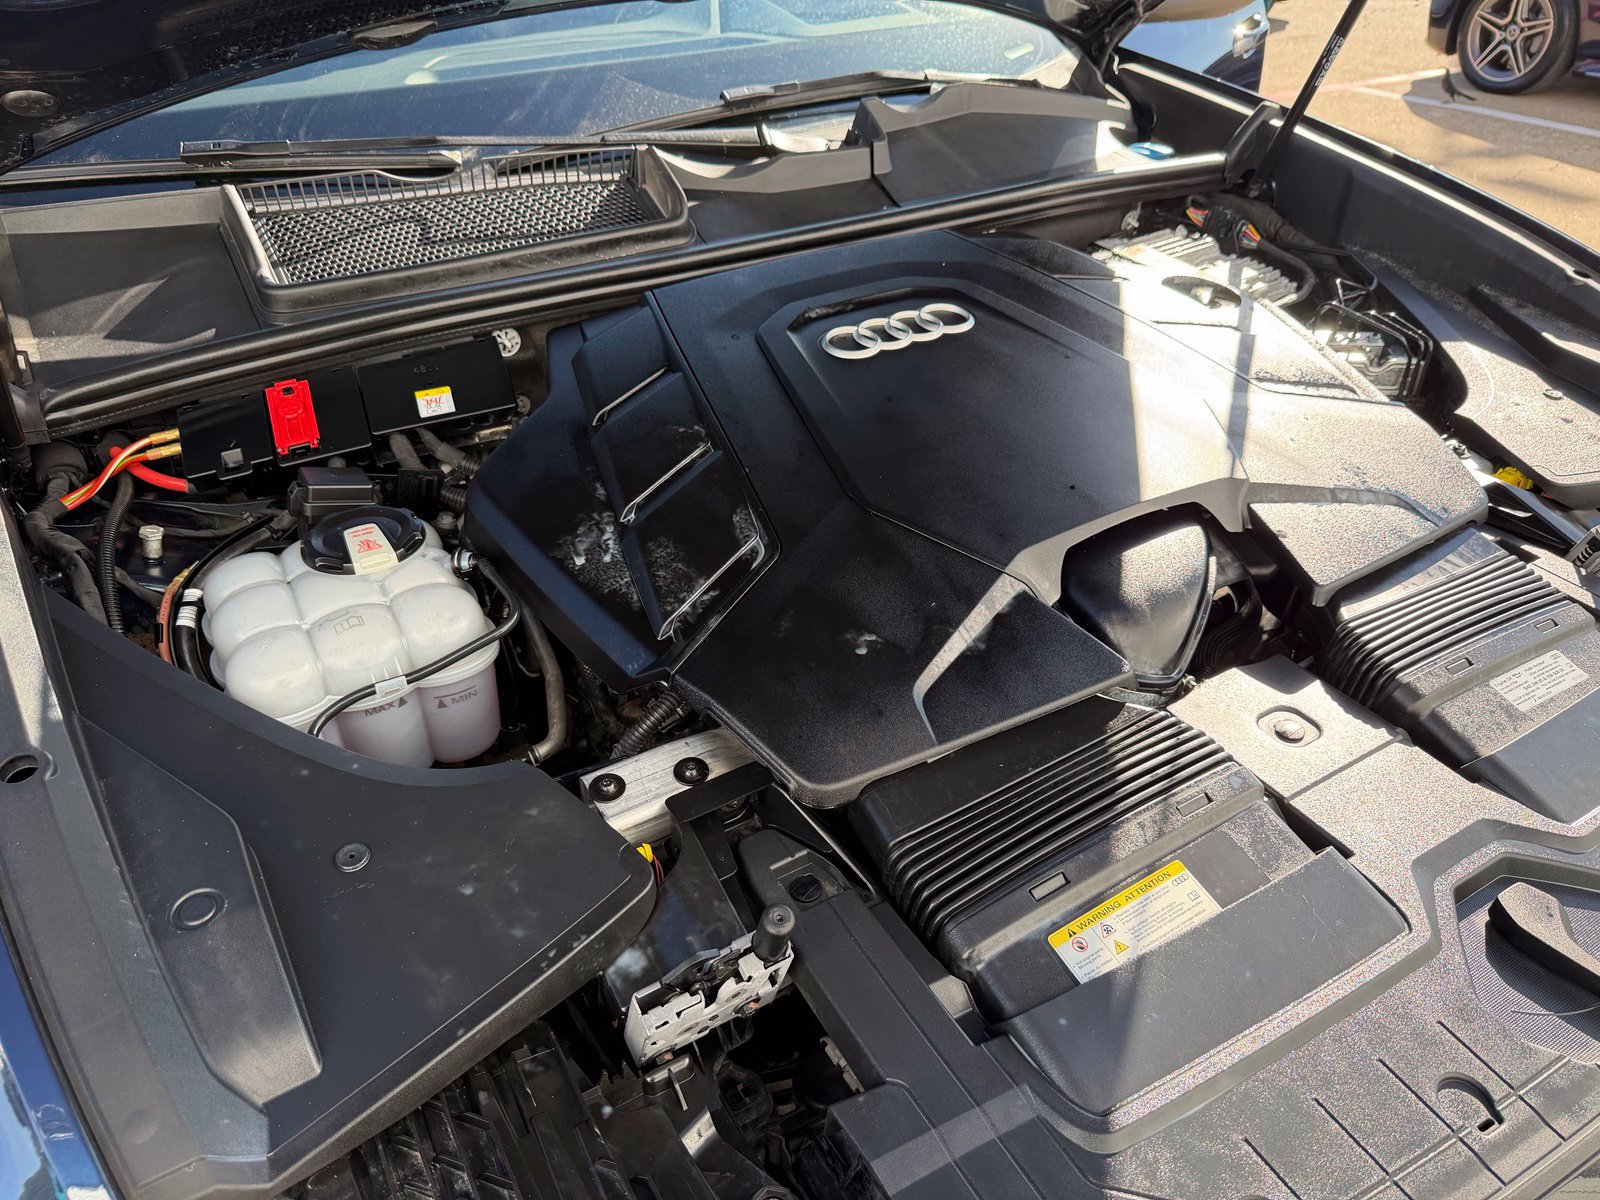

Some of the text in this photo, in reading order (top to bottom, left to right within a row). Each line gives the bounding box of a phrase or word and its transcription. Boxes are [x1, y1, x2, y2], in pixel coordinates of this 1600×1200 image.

[450, 689, 478, 705] MIN
[364, 700, 396, 717] MAX
[1077, 871, 1171, 930] WARNING ATTENTION
